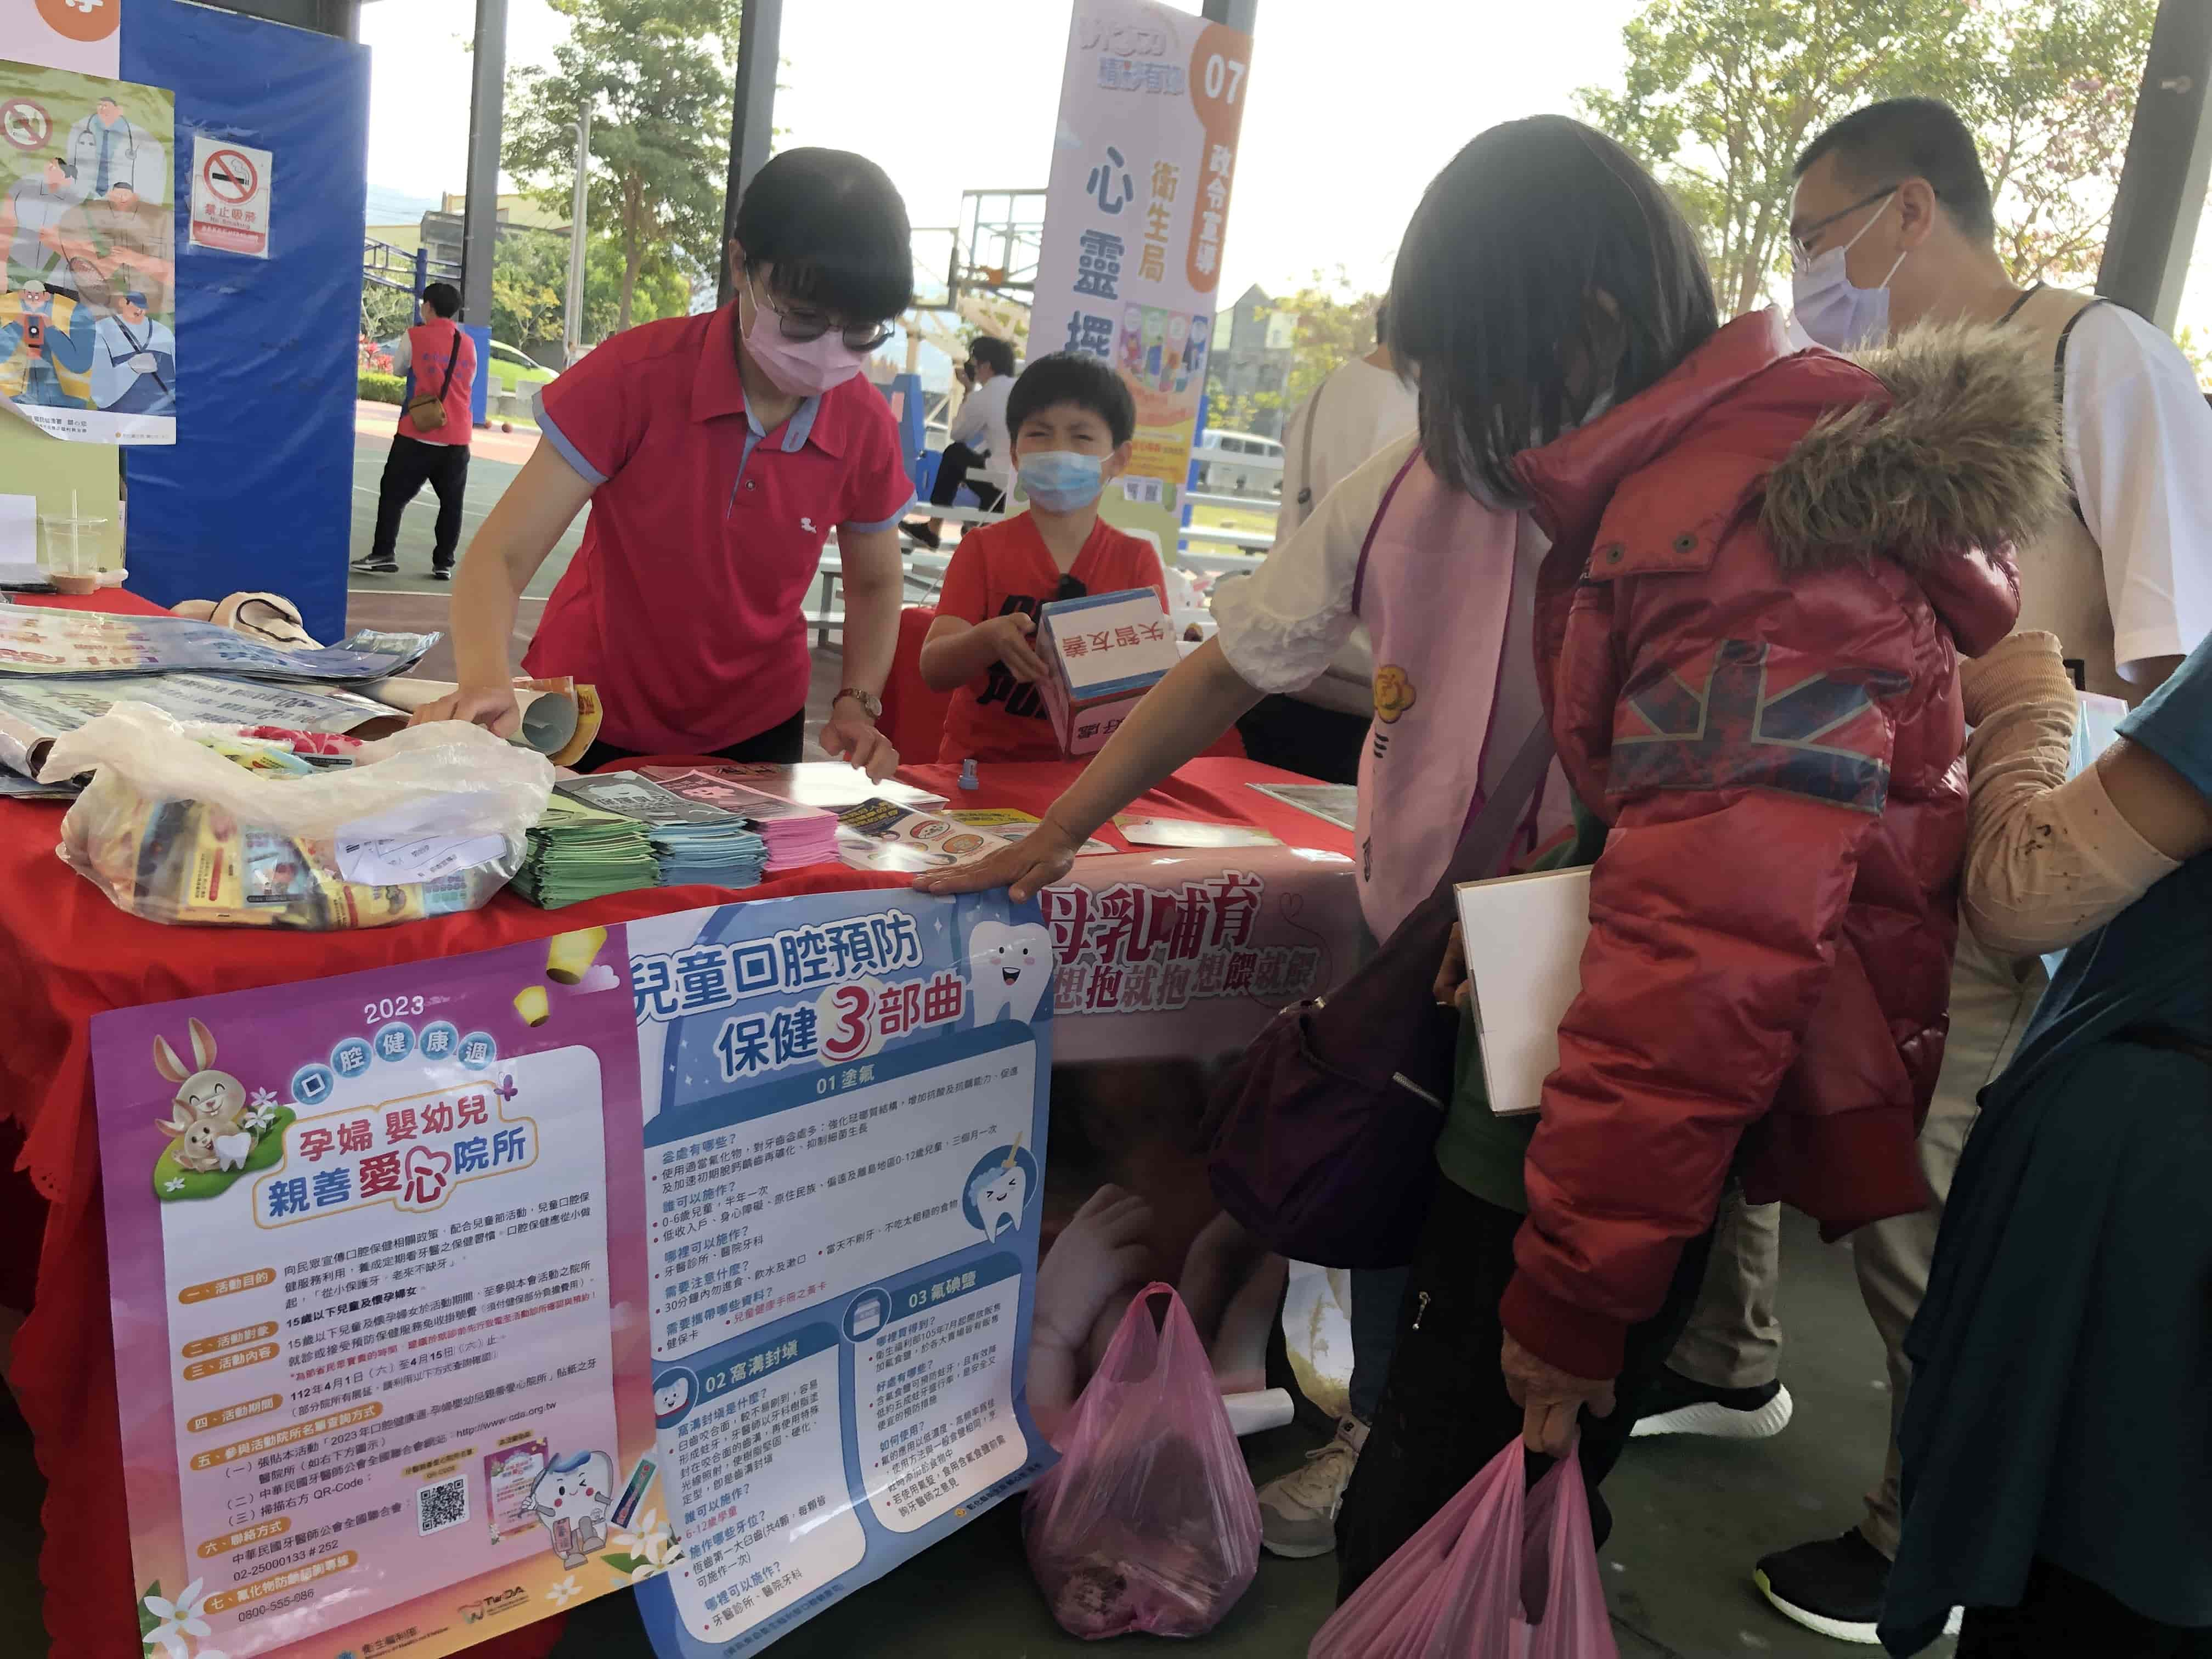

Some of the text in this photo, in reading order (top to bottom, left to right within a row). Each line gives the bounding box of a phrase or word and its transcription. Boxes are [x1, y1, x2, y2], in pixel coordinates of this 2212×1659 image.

[1205, 54, 1245, 105] 07
[1138, 159, 1179, 283] 衛生局
[1063, 620, 1166, 659] 失智友善
[1041, 872, 1262, 964] 母乳哺育
[631, 912, 924, 1018] 兒童口腔預防
[364, 995, 425, 1024] 2023
[718, 972, 964, 1077] 保健3部曲
[298, 1025, 492, 1099] 口腔健康週
[816, 1064, 875, 1094] 01 塗氟
[300, 1093, 488, 1161] 孕婦 嬰幼兒
[268, 1125, 527, 1219] 親善愛心院所
[187, 1271, 269, 1299] 一、活動目的
[909, 1293, 926, 1308] 03
[666, 1329, 699, 1351] 健保卡
[191, 1346, 273, 1378] 三、活動內容
[705, 1374, 727, 1393] 02
[194, 1397, 274, 1430] 四、活動期間
[233, 1550, 306, 1581] 02-25000133
[697, 1551, 751, 1589] 可施作一次)
